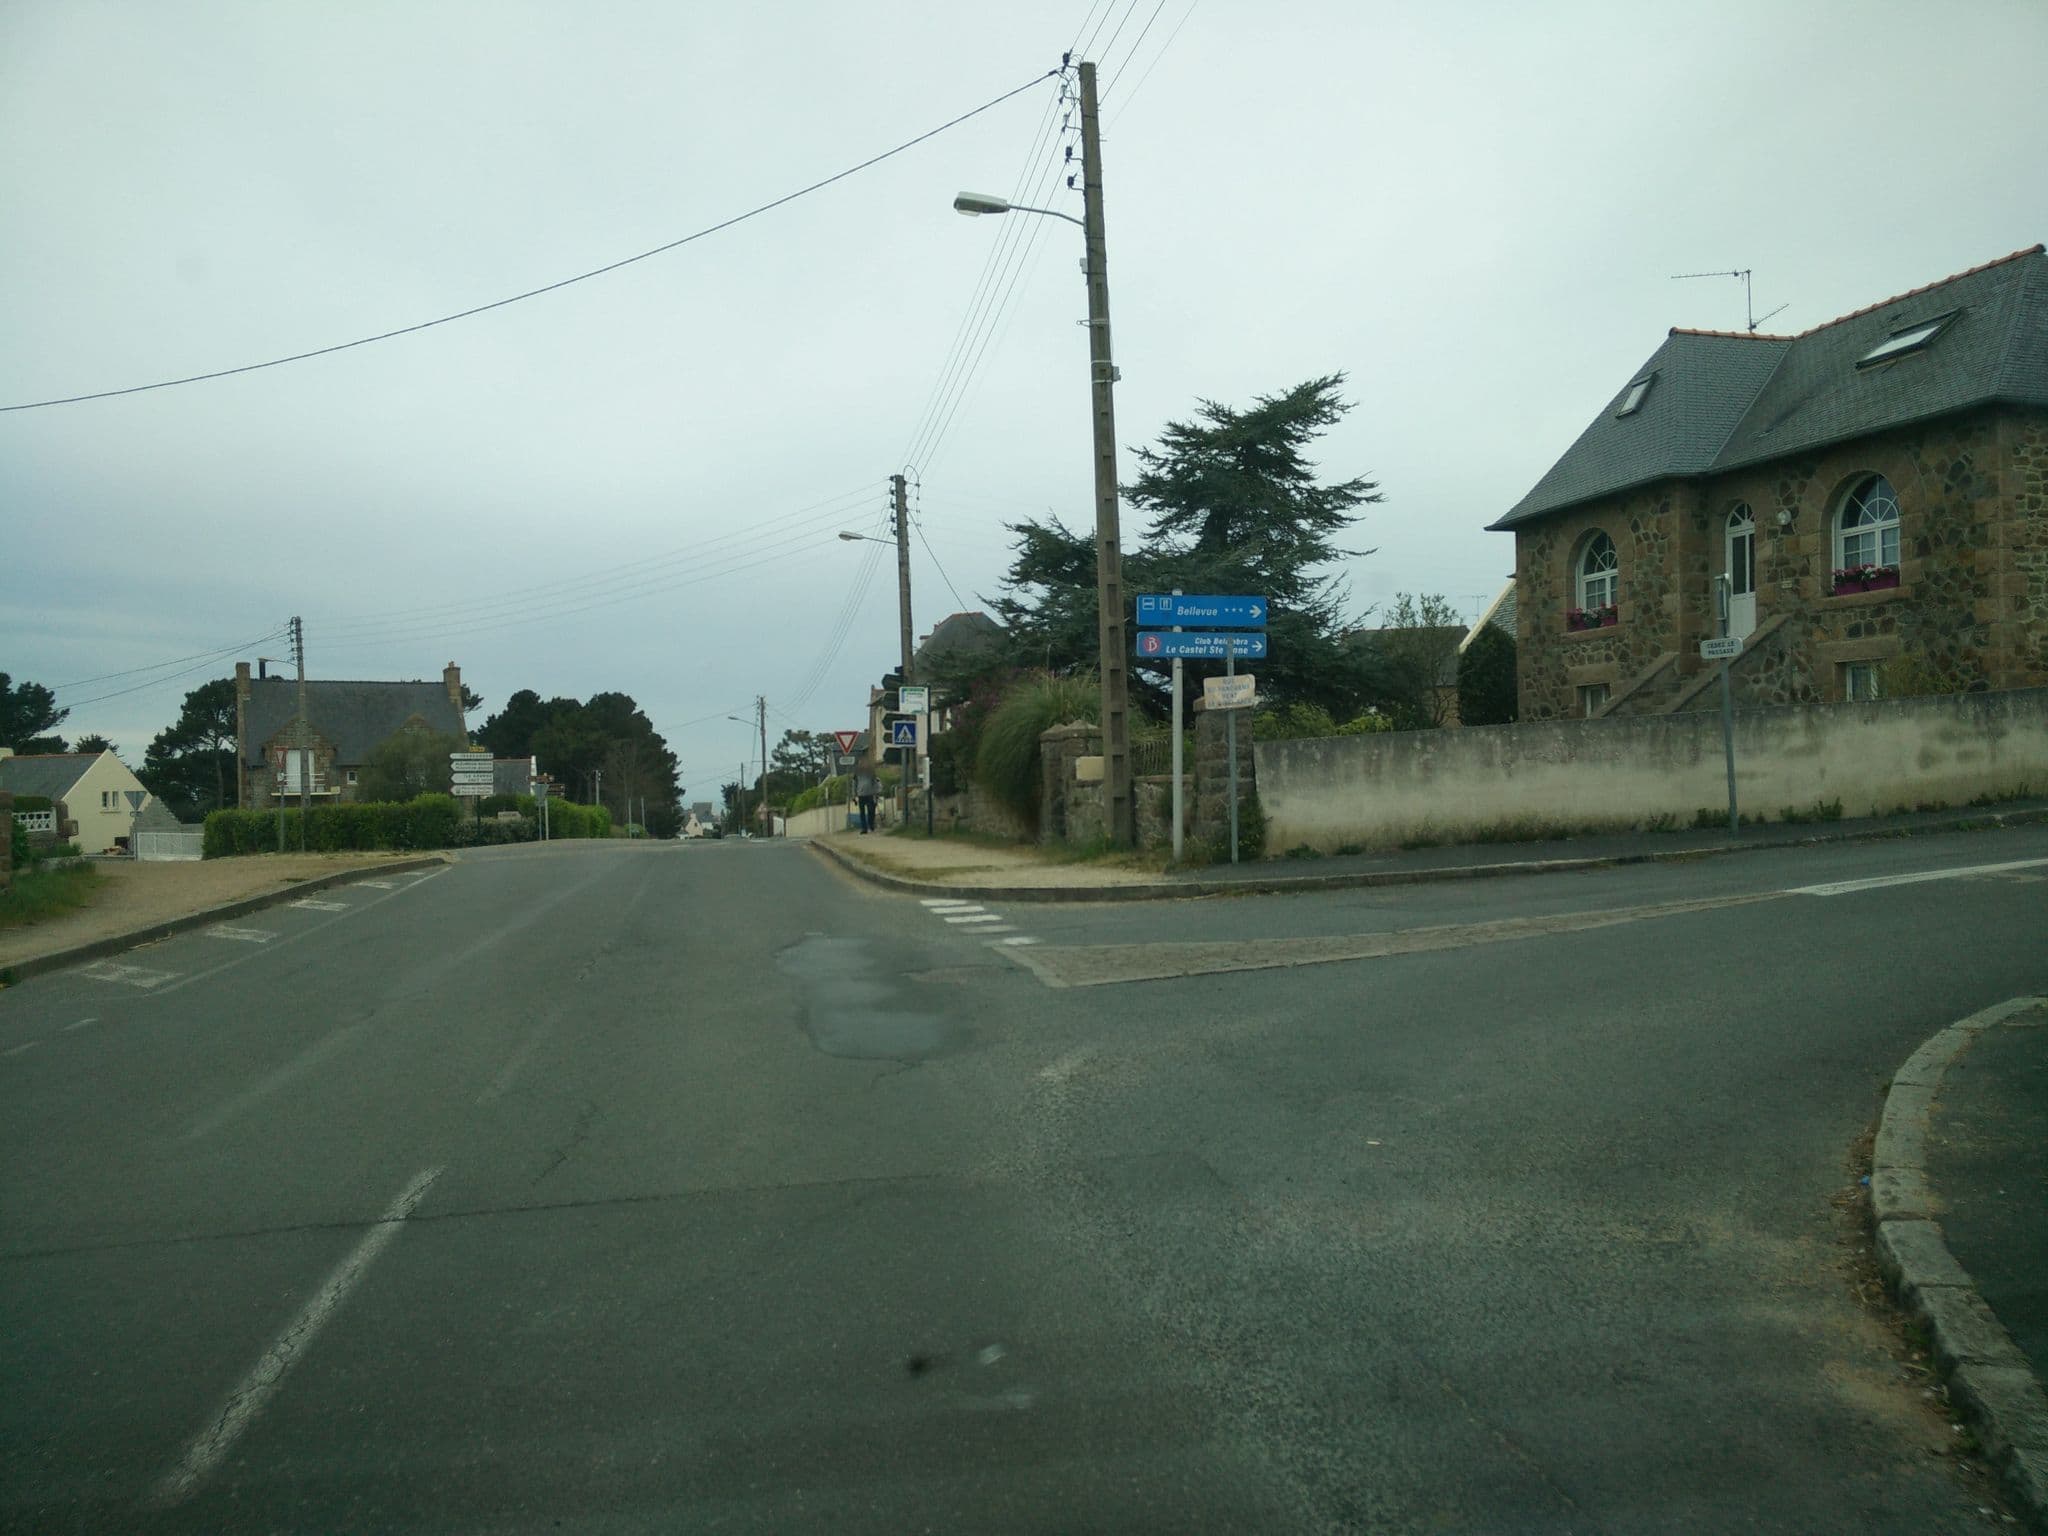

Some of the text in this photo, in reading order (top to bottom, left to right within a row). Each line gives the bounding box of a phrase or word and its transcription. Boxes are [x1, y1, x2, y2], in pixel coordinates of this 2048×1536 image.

[1176, 606, 1218, 616] Bellevue
[1194, 637, 1212, 645] Club
[1166, 646, 1176, 654] Le
[1179, 646, 1206, 654] Castel
[1209, 646, 1224, 654] Ste
